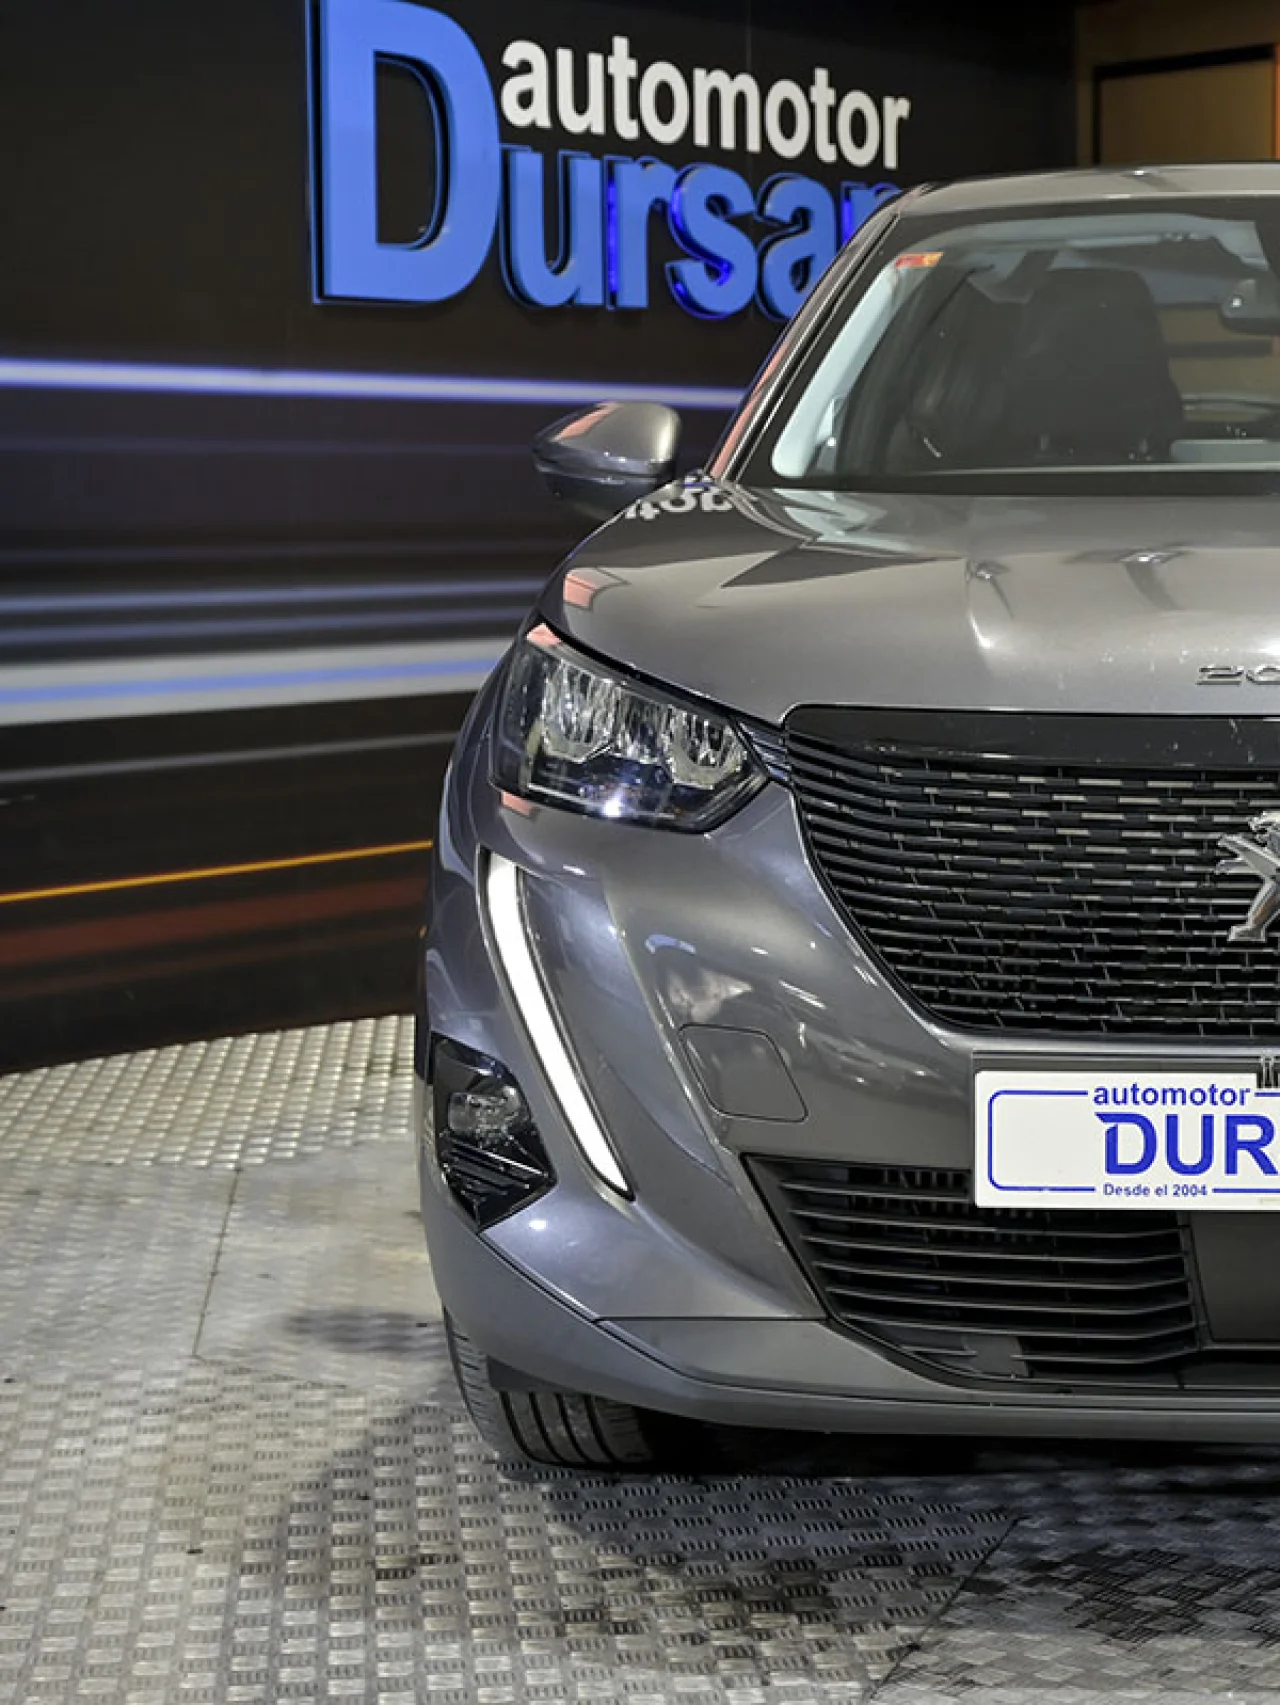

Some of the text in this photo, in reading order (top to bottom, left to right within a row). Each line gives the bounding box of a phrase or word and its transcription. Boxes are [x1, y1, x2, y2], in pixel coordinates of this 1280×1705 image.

[501, 36, 910, 169] automotor
[304, 0, 903, 321] Dursa
[1093, 1082, 1251, 1106] automotor
[1103, 1183, 1208, 1197] Desde el 2004
